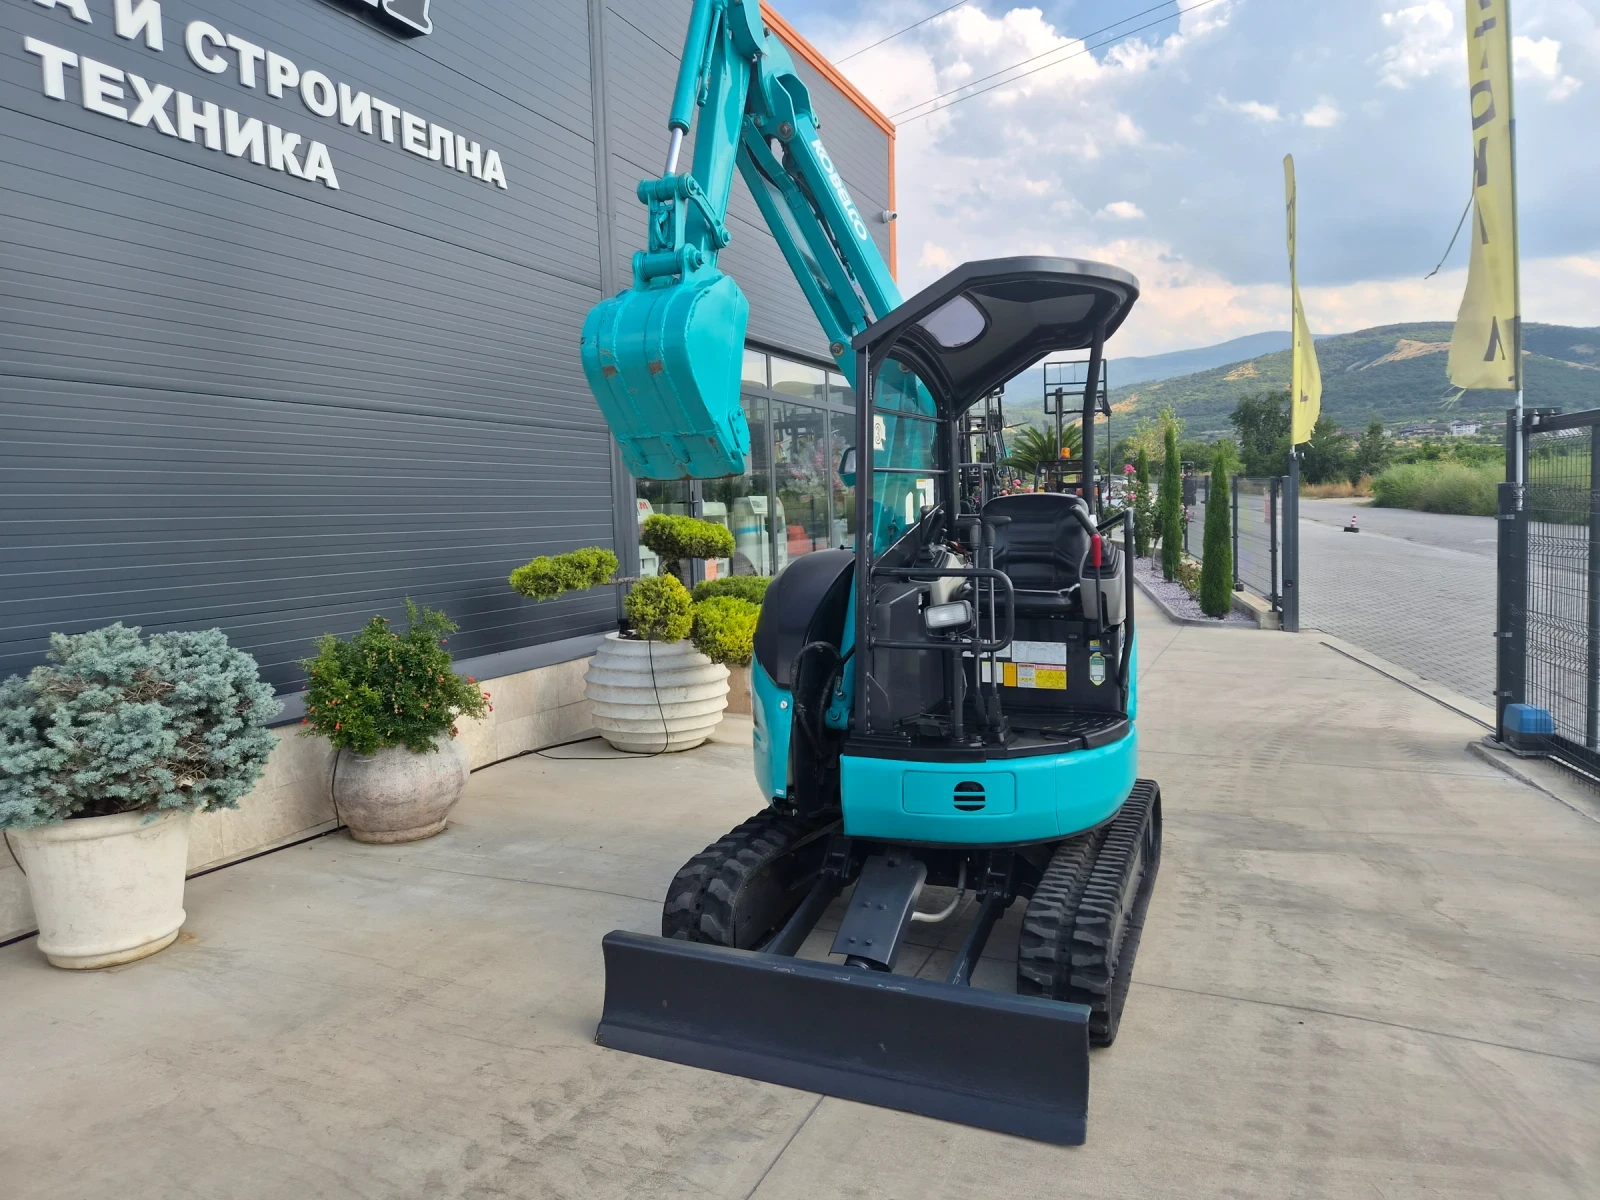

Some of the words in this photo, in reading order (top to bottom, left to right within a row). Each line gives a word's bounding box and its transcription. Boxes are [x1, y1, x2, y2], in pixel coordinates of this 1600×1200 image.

[24, 35, 340, 190] ТЕХНИКА
[115, 0, 163, 51] И
[185, 20, 508, 190] СТРОИТЕЛНА
[811, 139, 868, 241] KOBELCO
